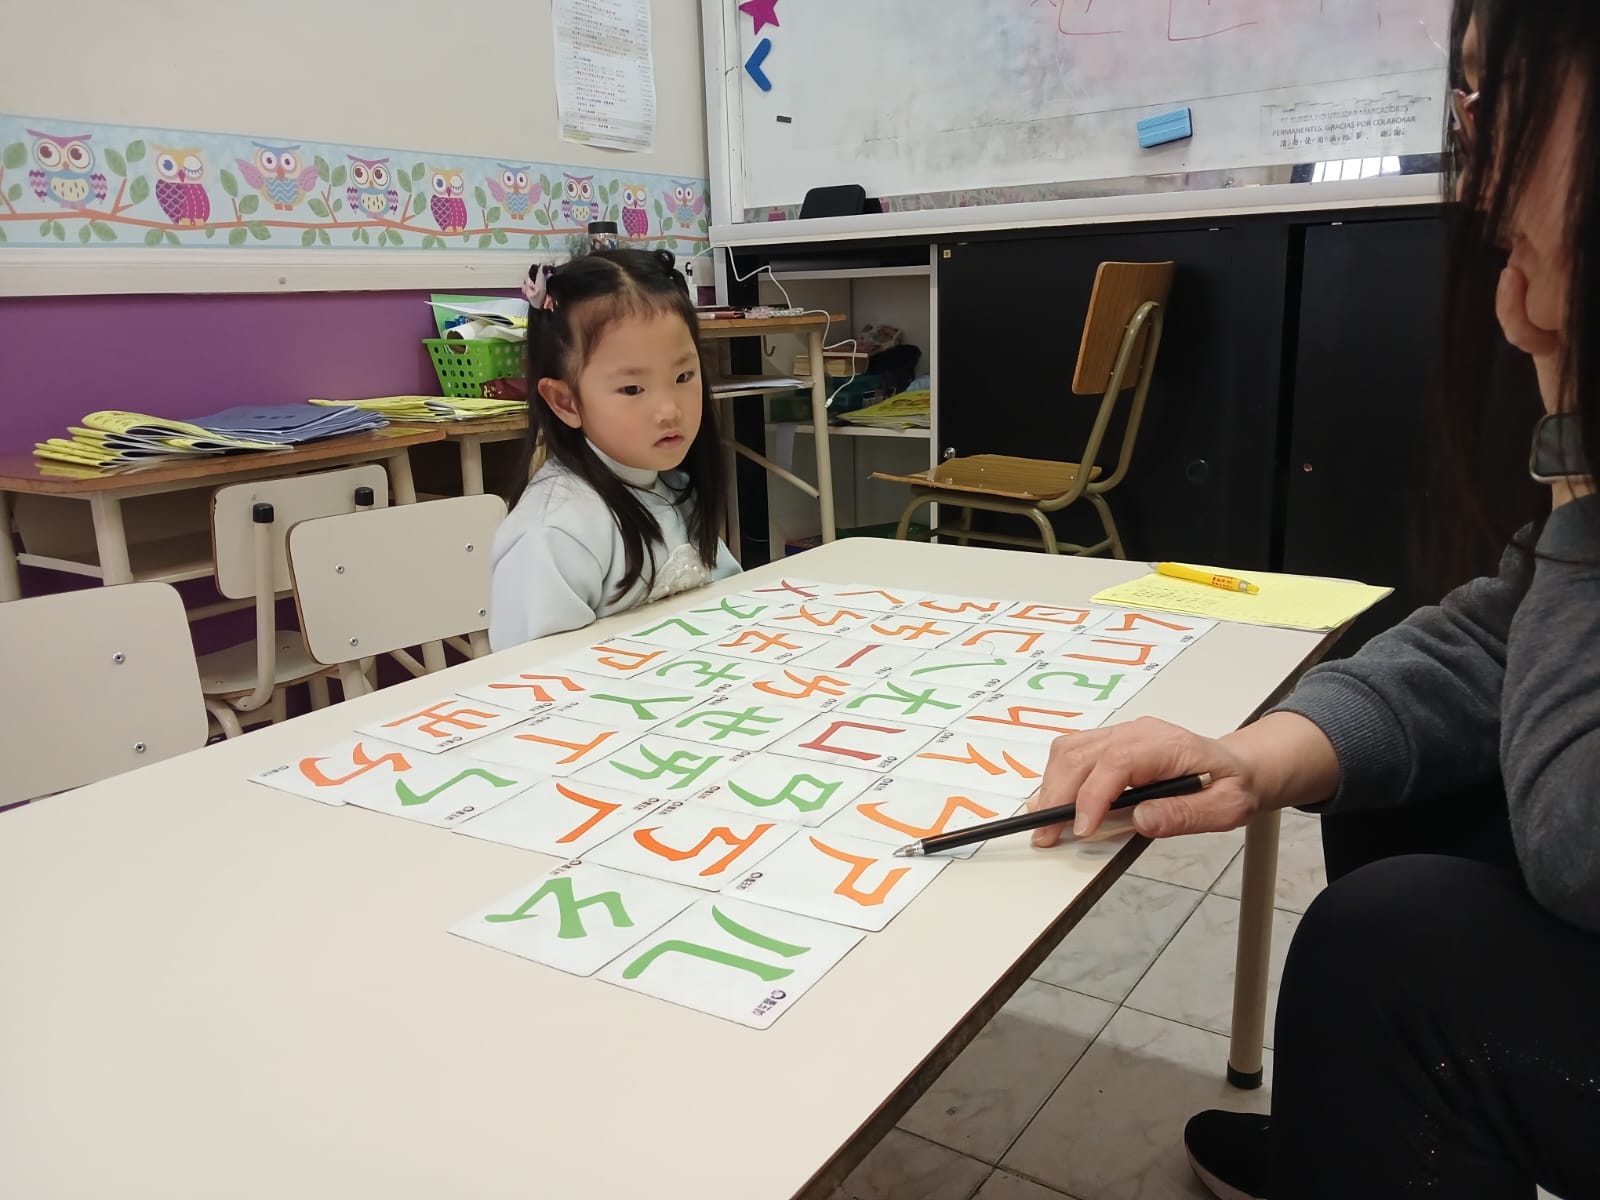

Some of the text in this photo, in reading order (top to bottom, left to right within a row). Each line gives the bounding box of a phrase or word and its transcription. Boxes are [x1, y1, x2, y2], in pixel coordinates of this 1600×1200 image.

[753, 579, 819, 597] ㄨ
[690, 598, 768, 620] ㄡ
[774, 604, 865, 627] ㄆ
[919, 601, 1000, 615] ㄋ
[1009, 604, 1091, 625] ㄖ
[1106, 613, 1193, 631] ㄙ
[718, 630, 801, 653] ㄊ
[871, 621, 950, 641] ㄘ
[962, 629, 1044, 652] ㄈ
[591, 646, 668, 672] ㄗ
[1063, 639, 1158, 666] ㄇ
[488, 673, 586, 702] ㄍ
[655, 660, 746, 688] ㄜ
[752, 670, 851, 700] ㄌ
[589, 693, 695, 721] ㄚ
[846, 681, 962, 716] ㄤ
[381, 700, 500, 738] ㄓ
[675, 706, 784, 741] ㄝ
[966, 705, 1083, 734] ㄐ
[514, 731, 619, 764] ㄒ
[798, 720, 907, 761] ㄩ
[299, 742, 412, 787] ㄉ
[608, 744, 726, 791] ㄞ
[917, 742, 1042, 779] ㄔ
[395, 768, 519, 807] ㄣ
[727, 773, 844, 814] ㄢ
[555, 782, 622, 844] ㄏ
[633, 823, 776, 877] ㄎ
[809, 835, 912, 907] ㄕ
[483, 876, 635, 939] ㄠ
[622, 904, 811, 983] ㄦ
